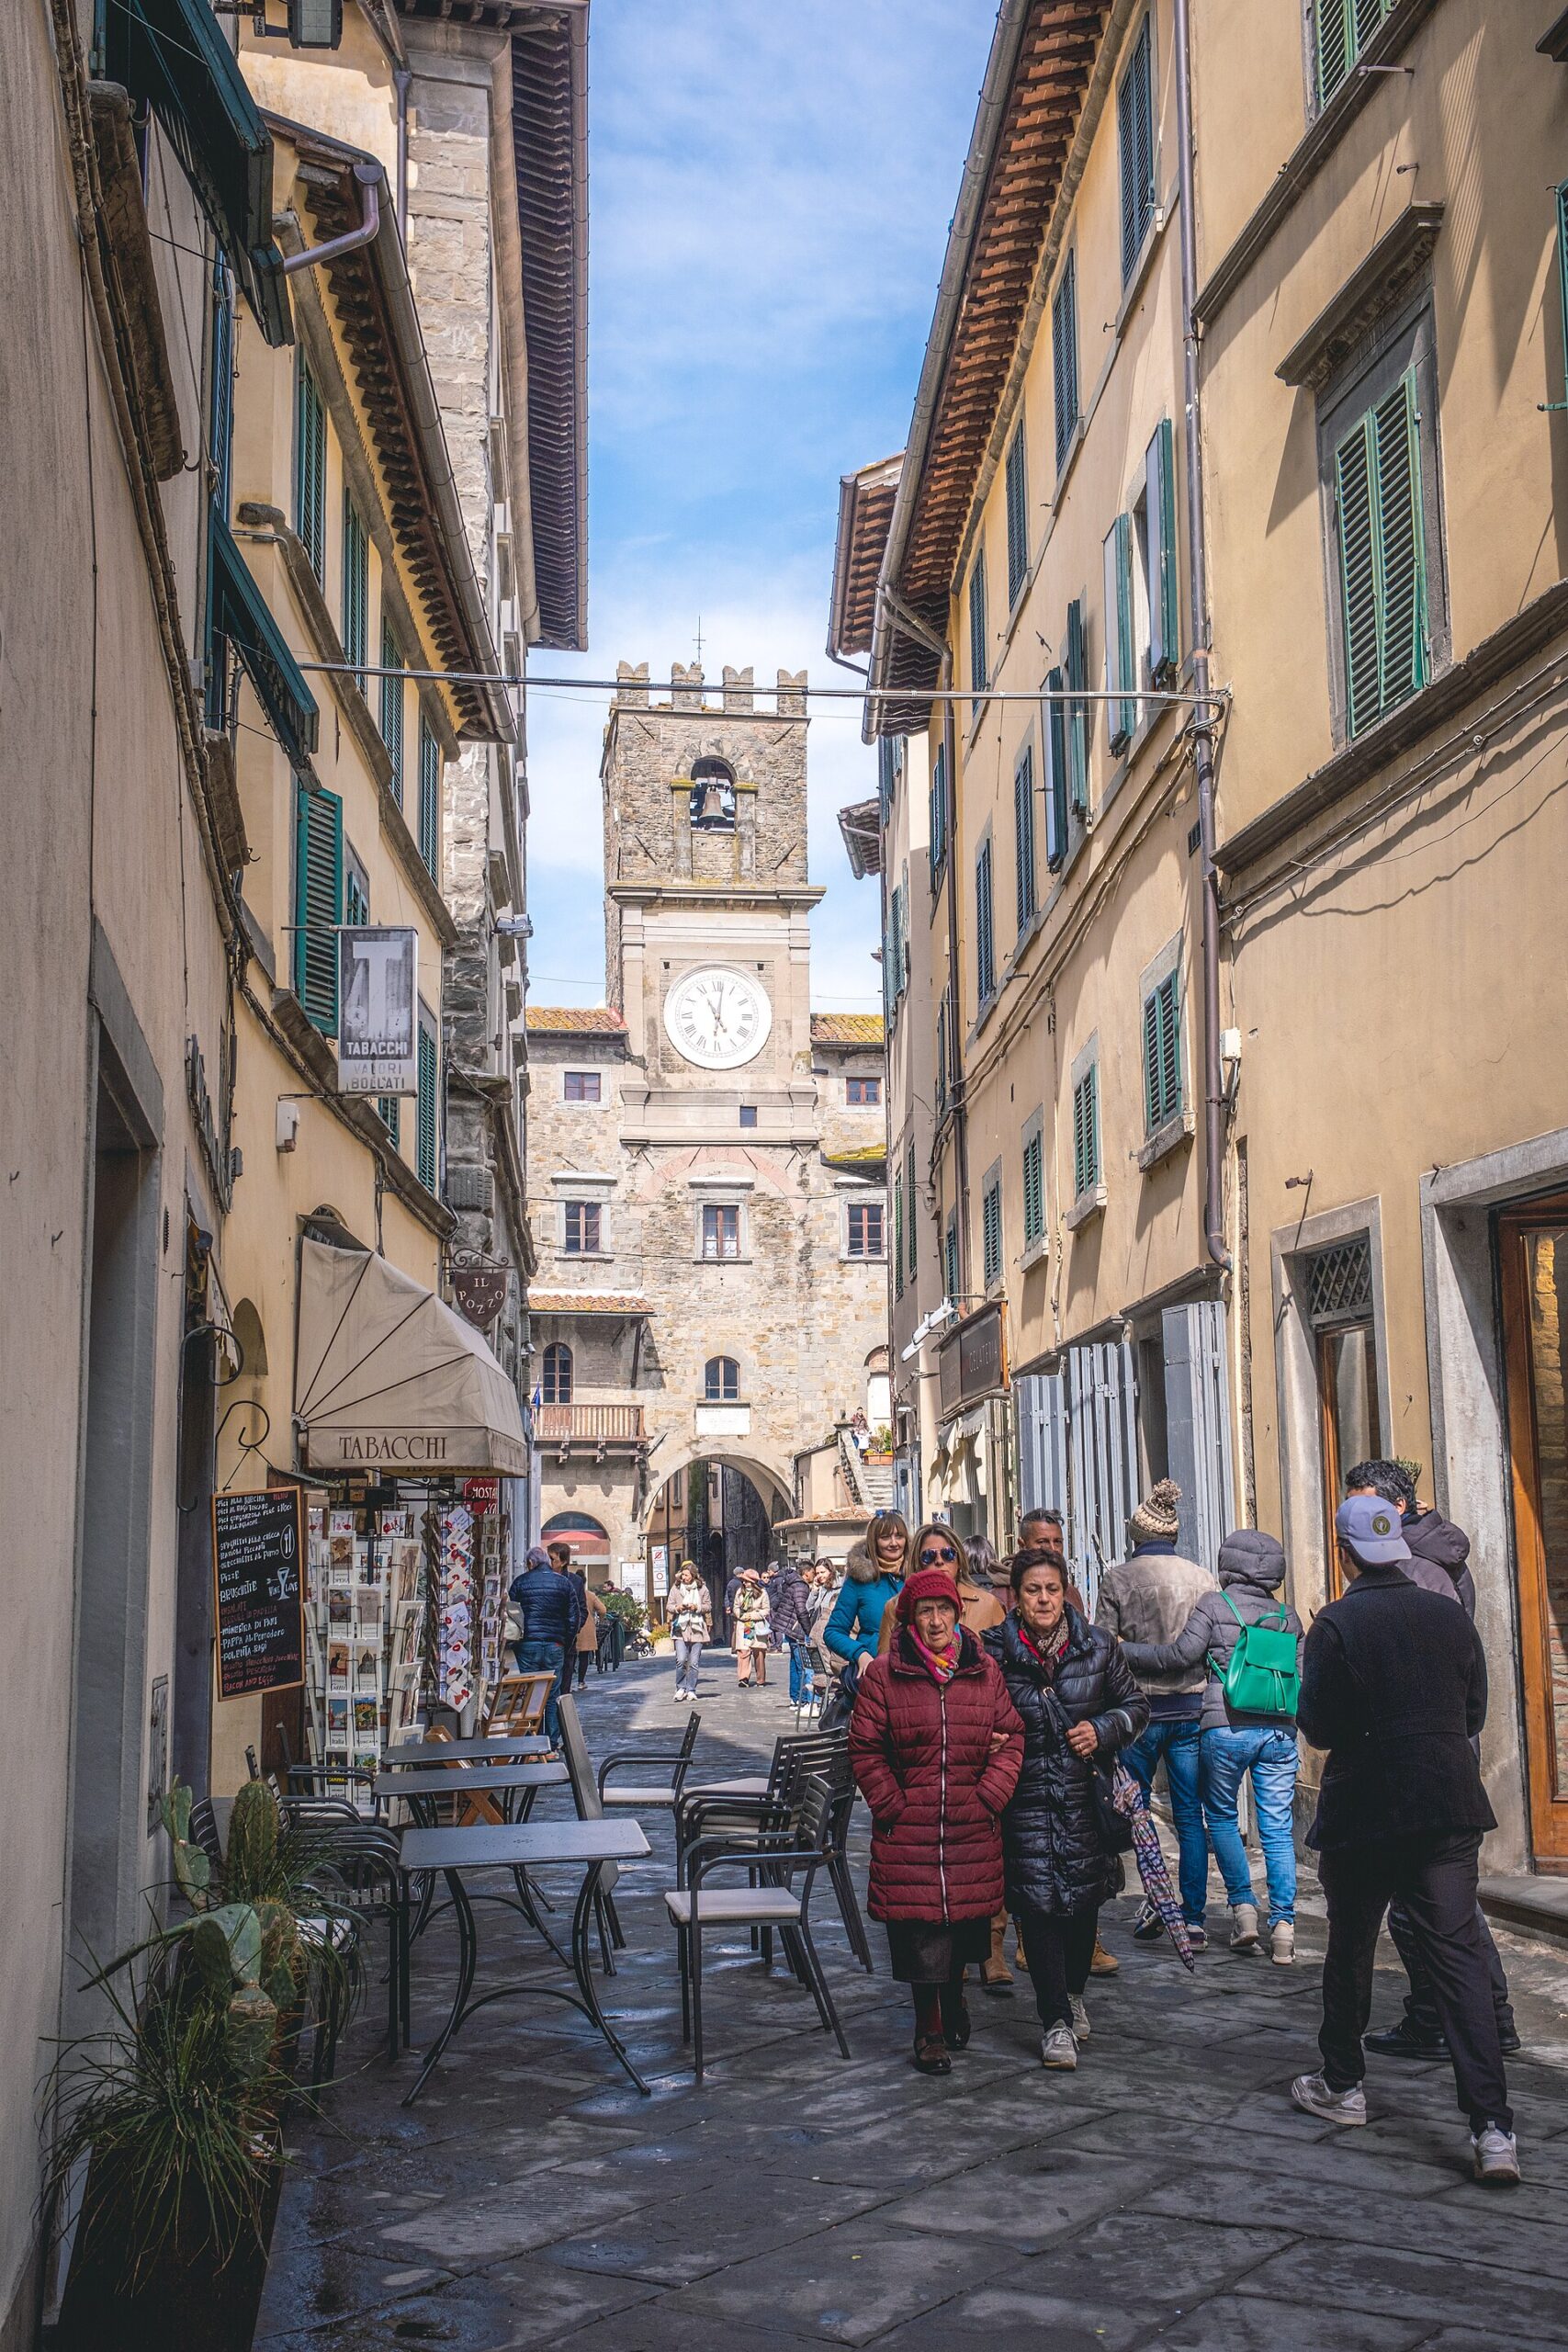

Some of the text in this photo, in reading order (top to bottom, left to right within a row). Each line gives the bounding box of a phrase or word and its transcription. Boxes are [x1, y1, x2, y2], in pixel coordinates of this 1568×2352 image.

[346, 1042, 407, 1055] TABACCHI
[354, 1063, 401, 1074] VALORI
[351, 1078, 404, 1089] BOLLATI
[474, 1278, 491, 1287] IL
[458, 1290, 504, 1314] POZZO
[339, 1436, 447, 1459] TABACCHI
